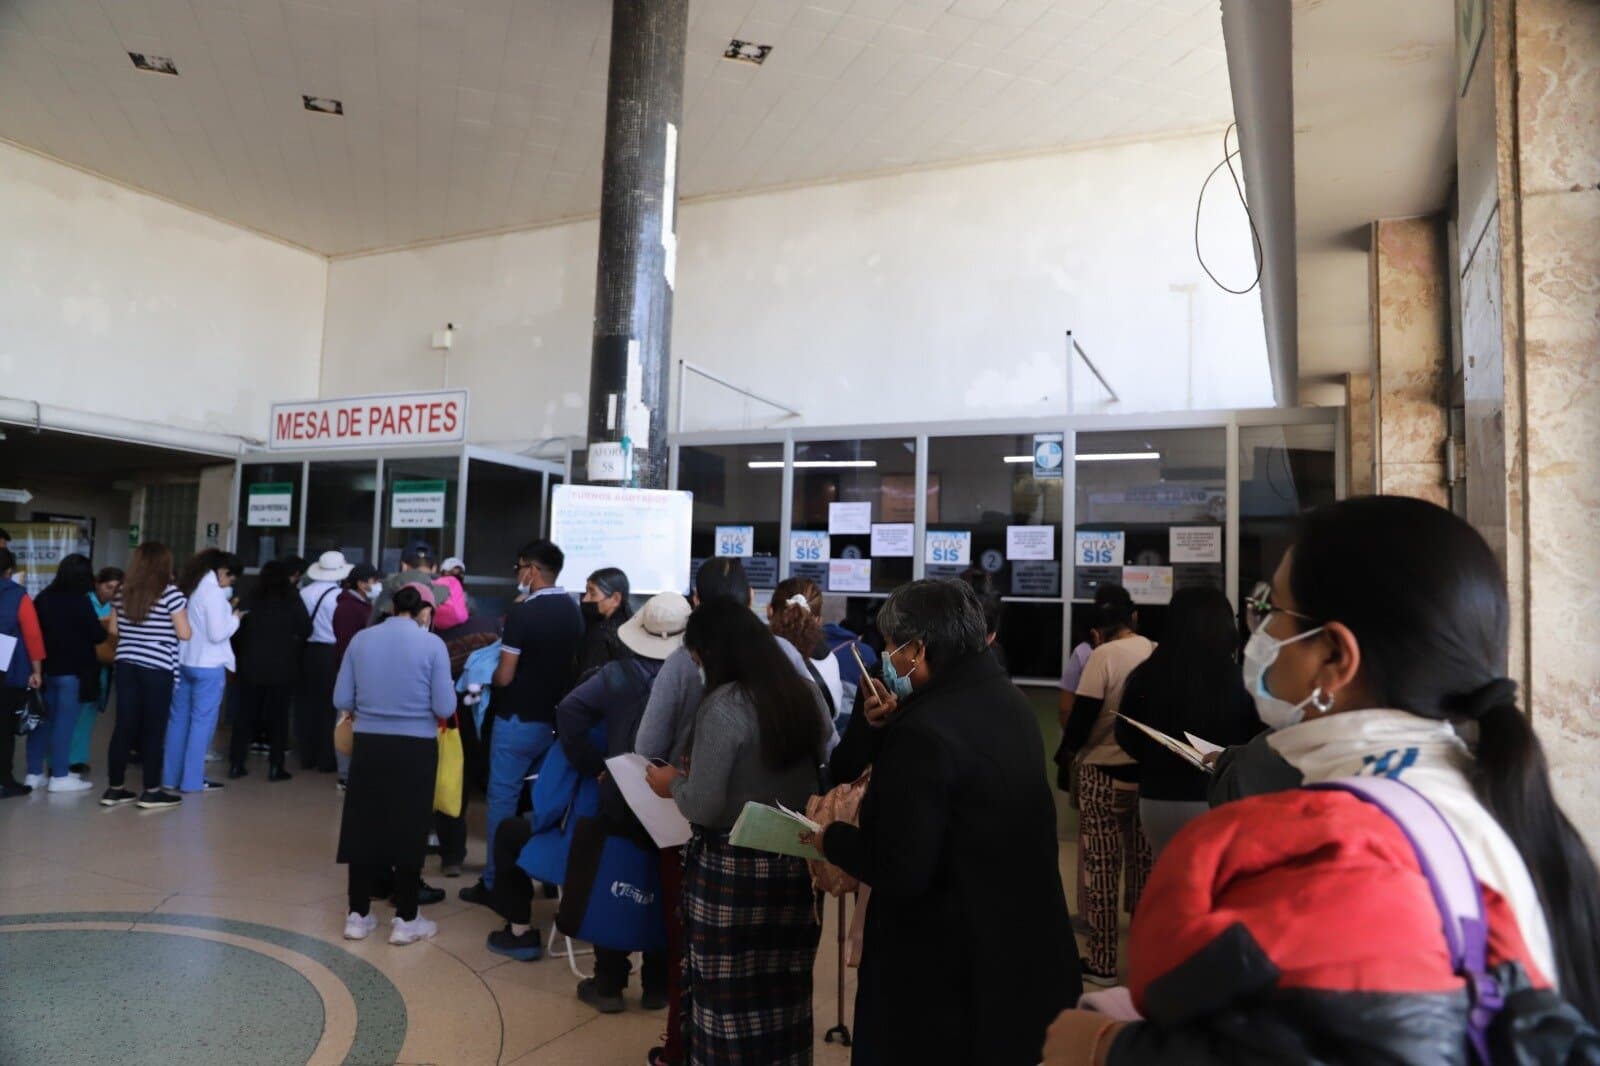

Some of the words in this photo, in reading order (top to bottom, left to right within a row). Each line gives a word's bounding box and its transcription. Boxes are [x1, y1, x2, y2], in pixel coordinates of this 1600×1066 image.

[276, 410, 331, 440] MESA
[336, 407, 363, 437] DE
[369, 401, 458, 436] PARTES
[720, 534, 747, 544] CITAS
[795, 538, 823, 548] CITAS
[931, 539, 963, 549] CITAS
[721, 544, 744, 554] SIS
[1081, 540, 1117, 550] CITAS
[796, 549, 821, 560] SIS
[932, 549, 959, 561] SIS
[1083, 551, 1112, 563] SIS
